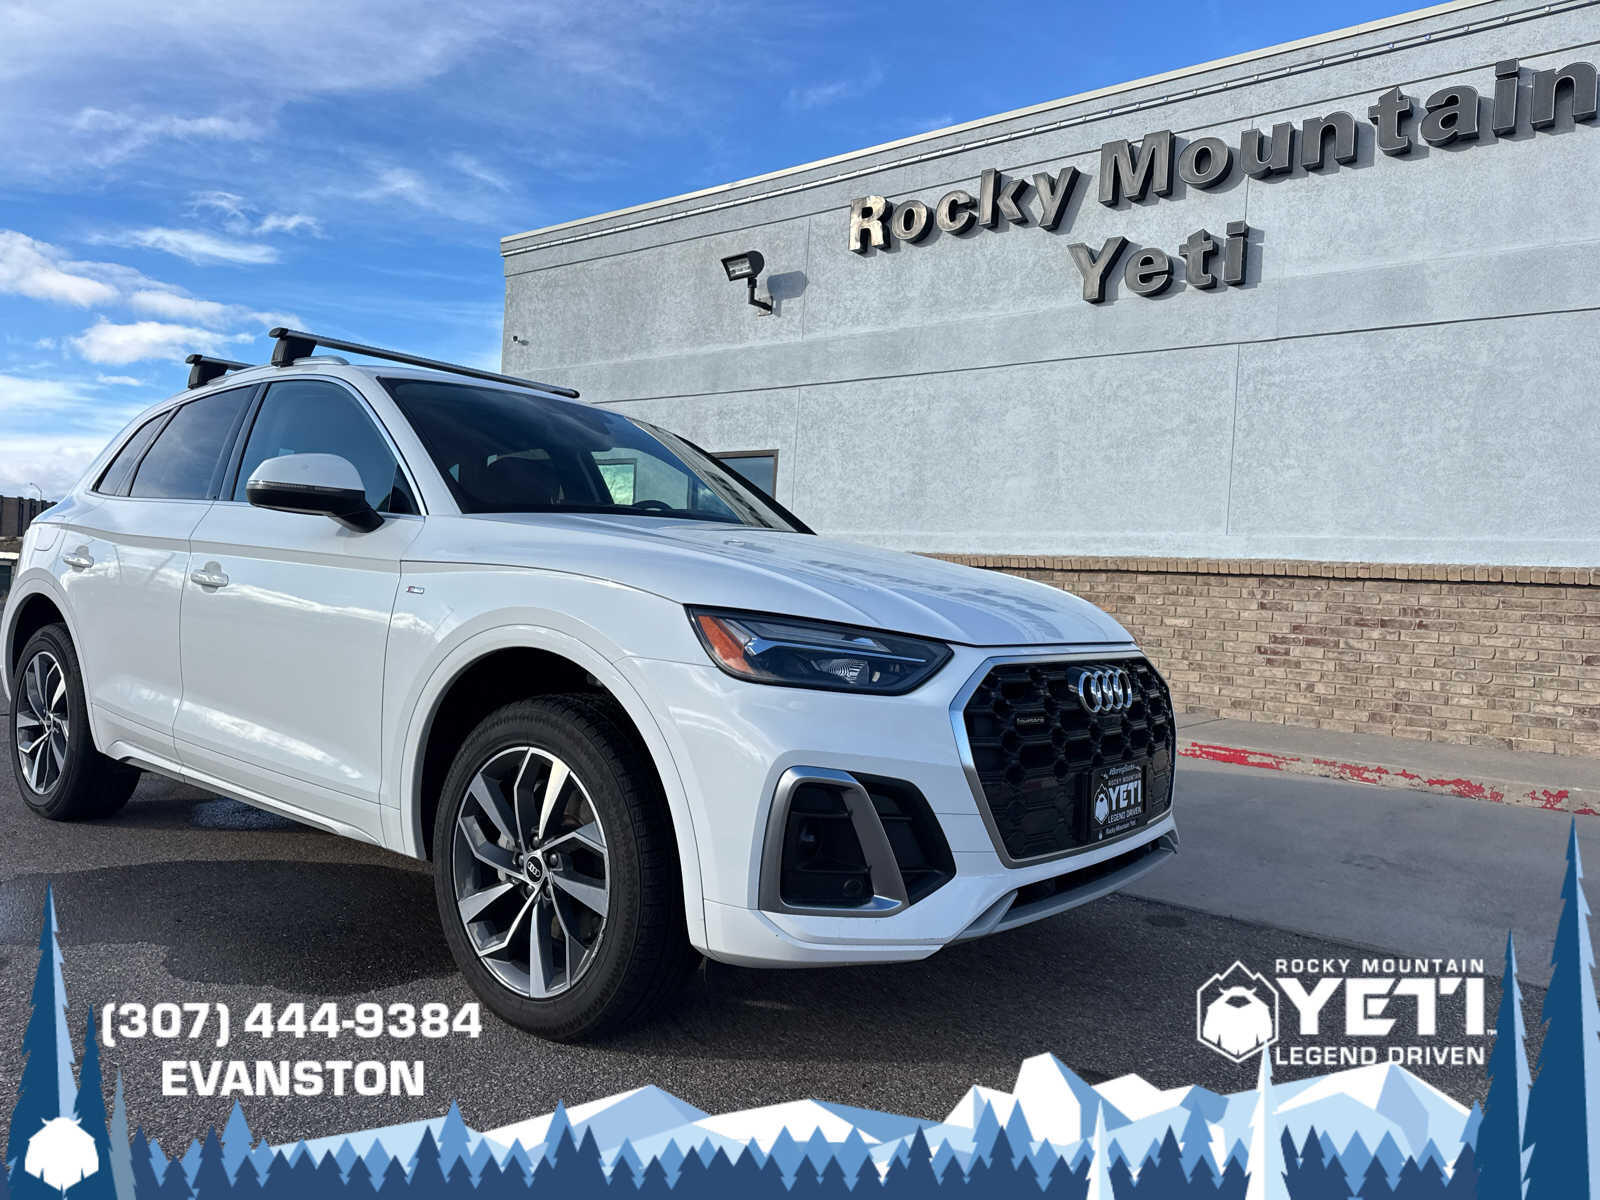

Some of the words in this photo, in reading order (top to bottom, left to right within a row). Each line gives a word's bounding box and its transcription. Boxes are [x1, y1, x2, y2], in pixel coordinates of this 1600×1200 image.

[849, 165, 1080, 254] Rocky
[1098, 57, 1600, 207] Mountain
[1067, 220, 1250, 304] Yeti
[1108, 779, 1142, 811] YETI
[1108, 812, 1126, 824] LEGEND
[1126, 806, 1142, 818] DRIVEN
